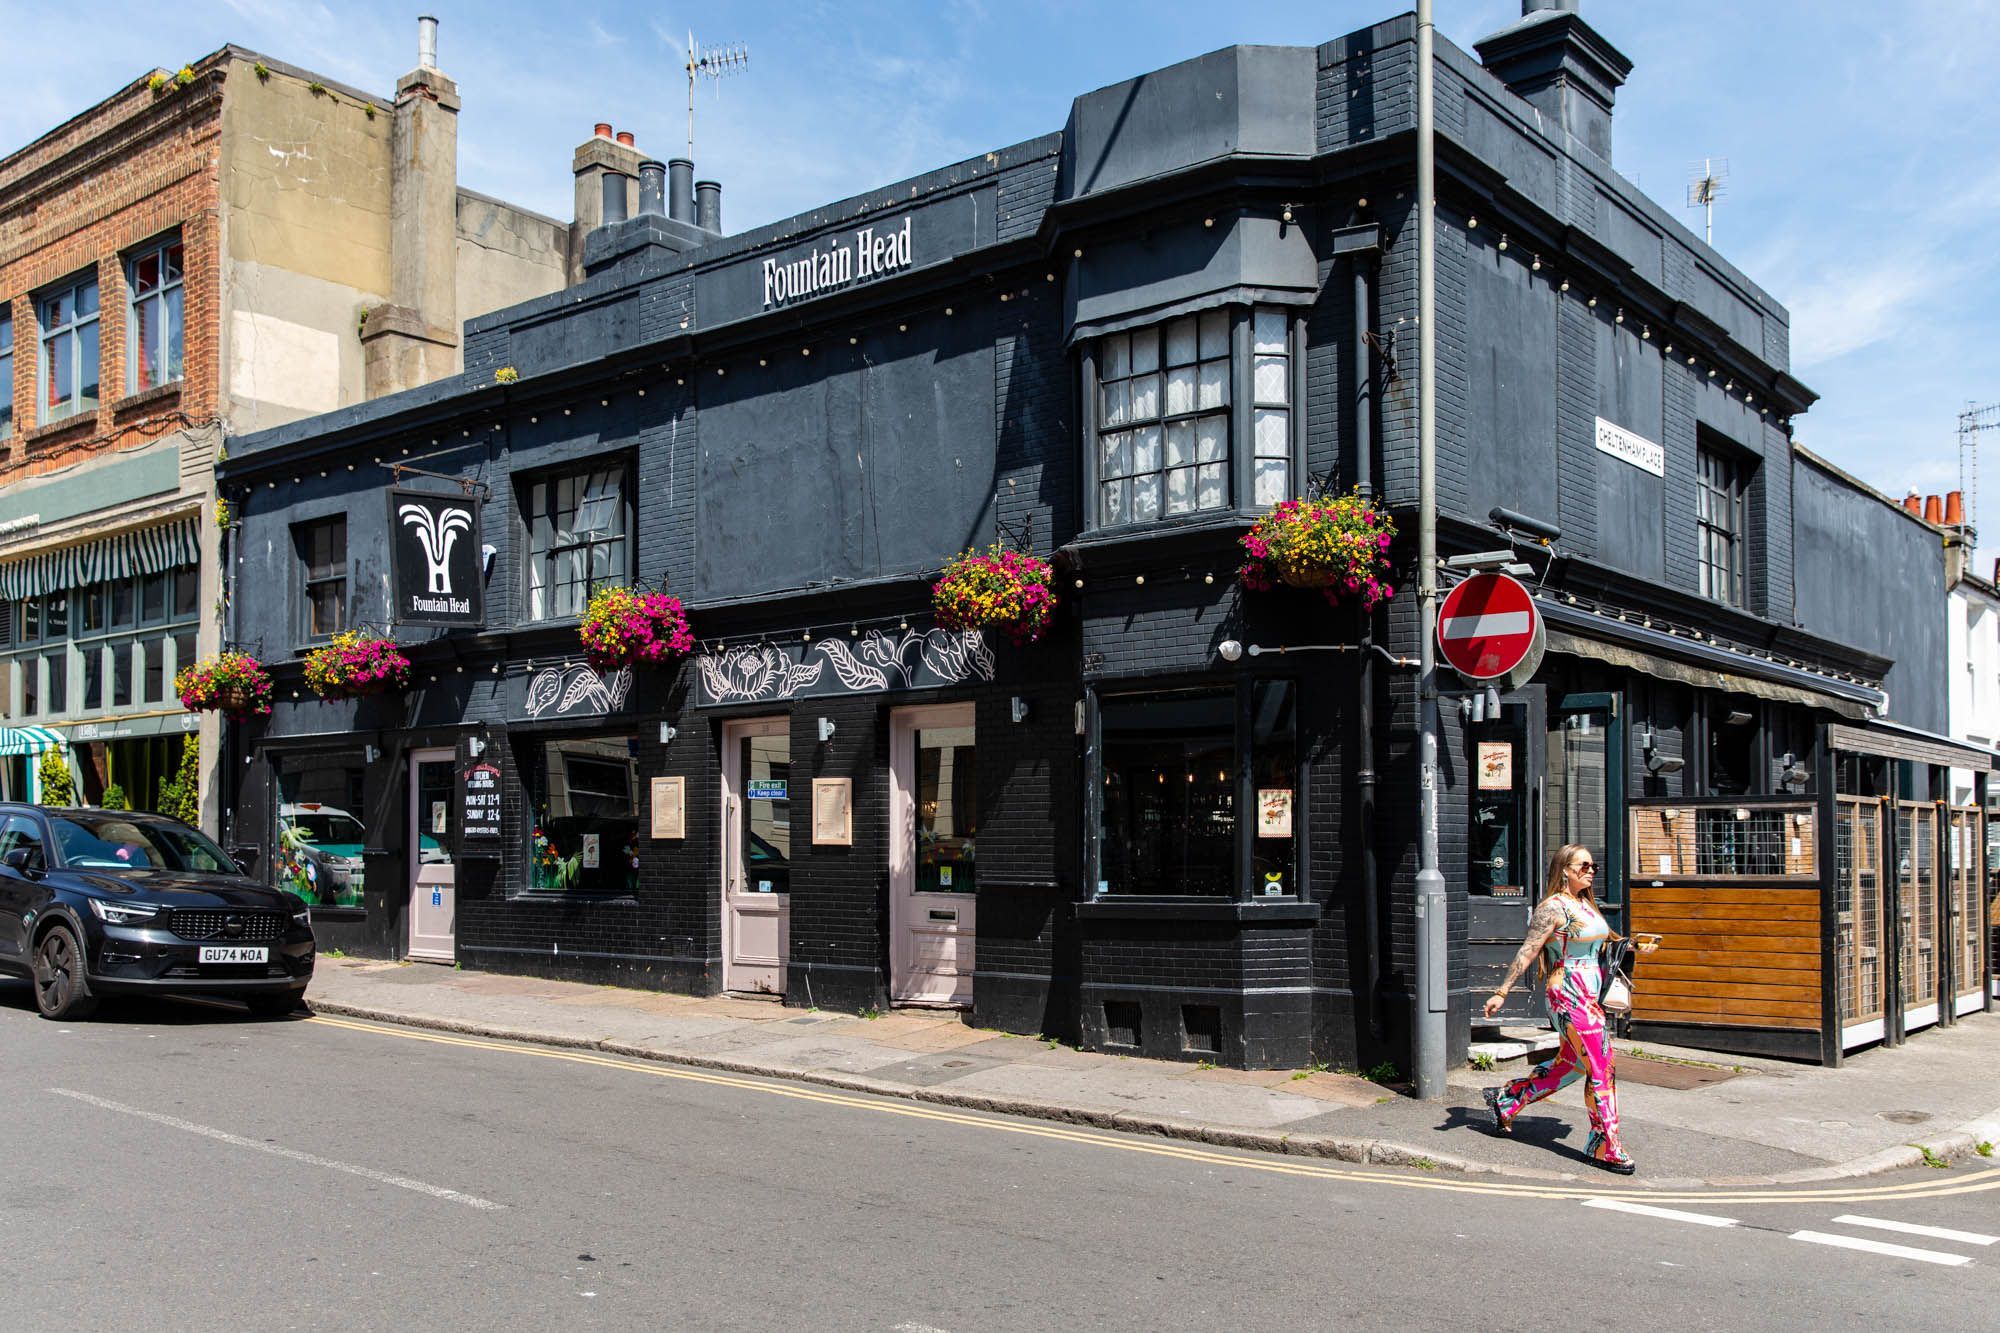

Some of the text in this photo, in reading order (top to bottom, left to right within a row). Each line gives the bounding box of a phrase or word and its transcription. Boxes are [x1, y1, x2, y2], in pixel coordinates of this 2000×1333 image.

[763, 217, 912, 305] Fountain Head
[1599, 427, 1661, 469] CHELTENHAM PLACE
[413, 595, 470, 613] Fountain Head
[760, 781, 770, 789] Fire
[465, 794, 500, 806] MON-SAT 12-9
[466, 809, 500, 821] SUNDAY 12-6
[205, 949, 237, 961] GU74
